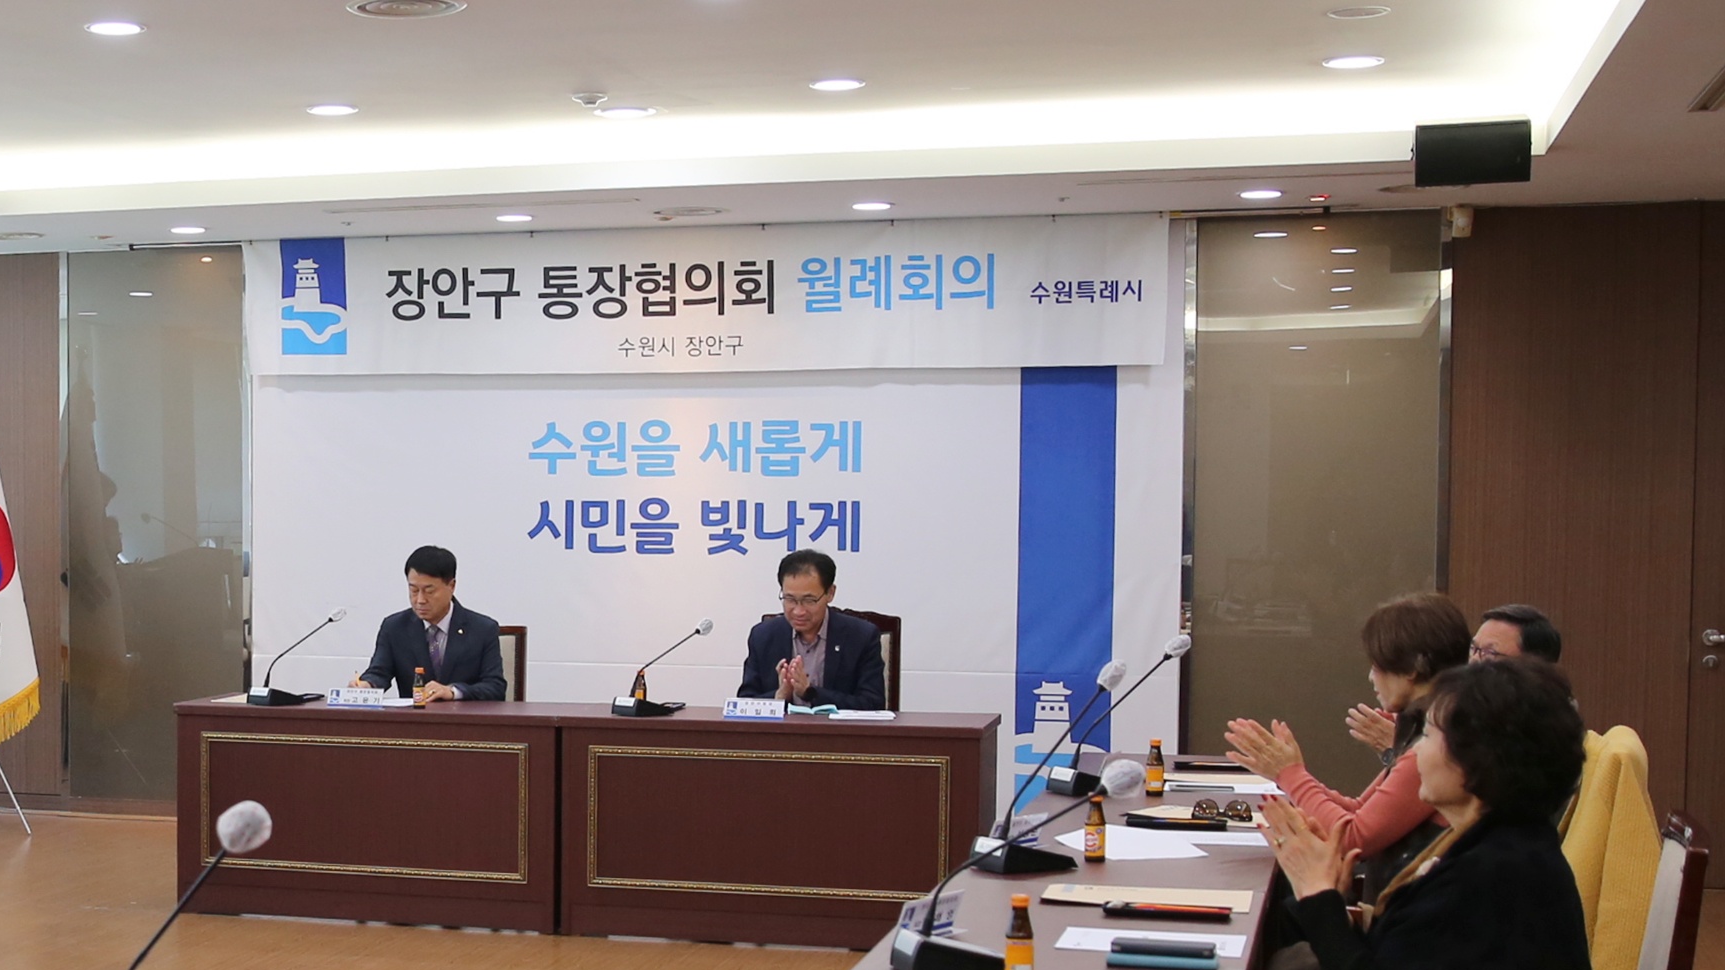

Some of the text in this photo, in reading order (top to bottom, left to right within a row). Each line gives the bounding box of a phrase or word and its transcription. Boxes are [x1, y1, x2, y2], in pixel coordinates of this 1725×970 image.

[385, 253, 996, 321] 장안구 통장협의회 월례회의
[1029, 279, 1144, 305] 수원특례시
[617, 334, 745, 358] 수원시 장안구
[528, 419, 863, 478] 수원을 새롭게
[527, 497, 862, 556] 시민을 빛나게
